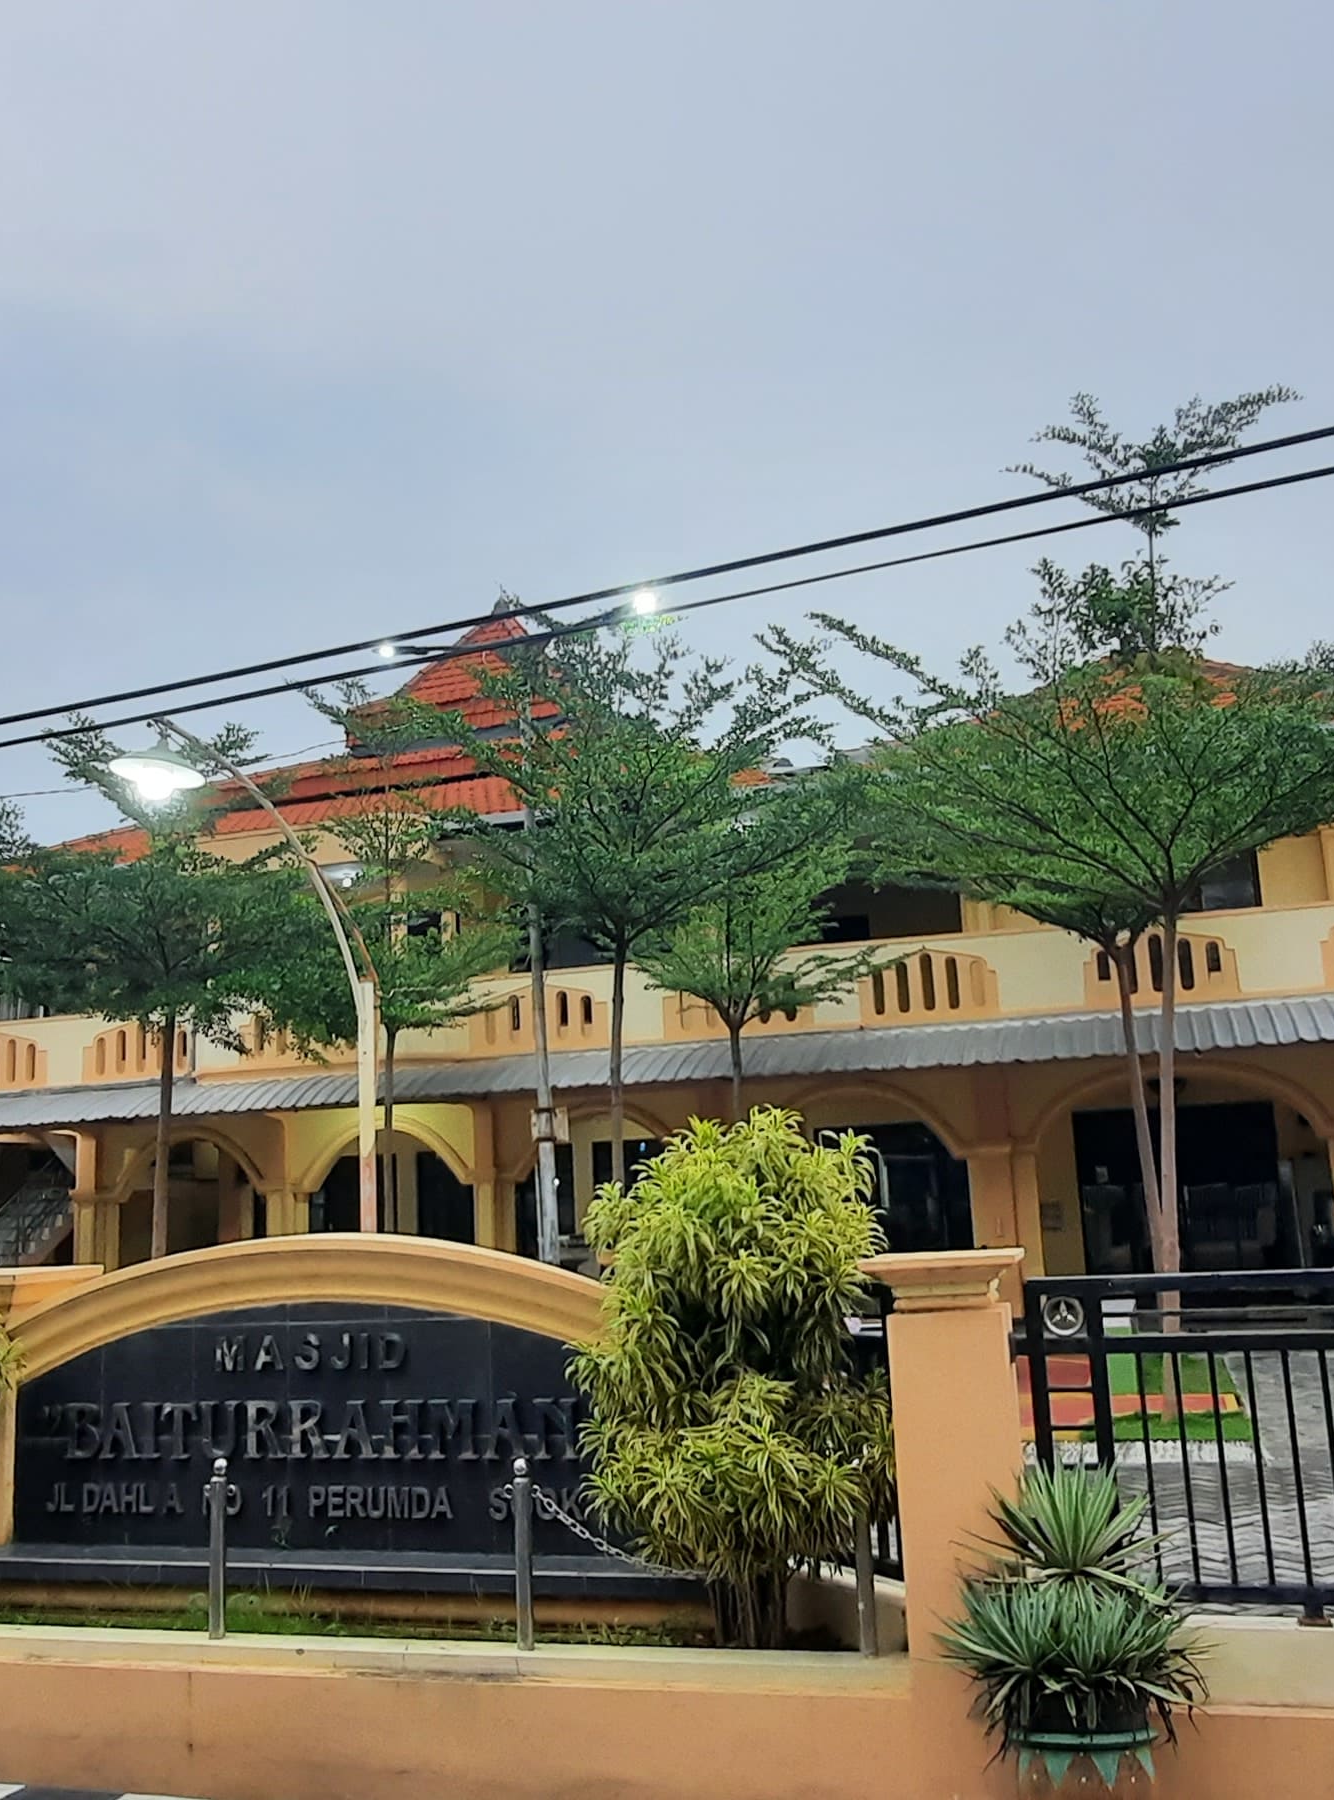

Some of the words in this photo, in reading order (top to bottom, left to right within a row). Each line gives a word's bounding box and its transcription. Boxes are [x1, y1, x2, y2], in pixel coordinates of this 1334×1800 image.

[215, 1332, 406, 1371] MASJID
[46, 1483, 75, 1512] JL
[262, 1485, 289, 1517] 11
[308, 1485, 454, 1520] PERUMDA
